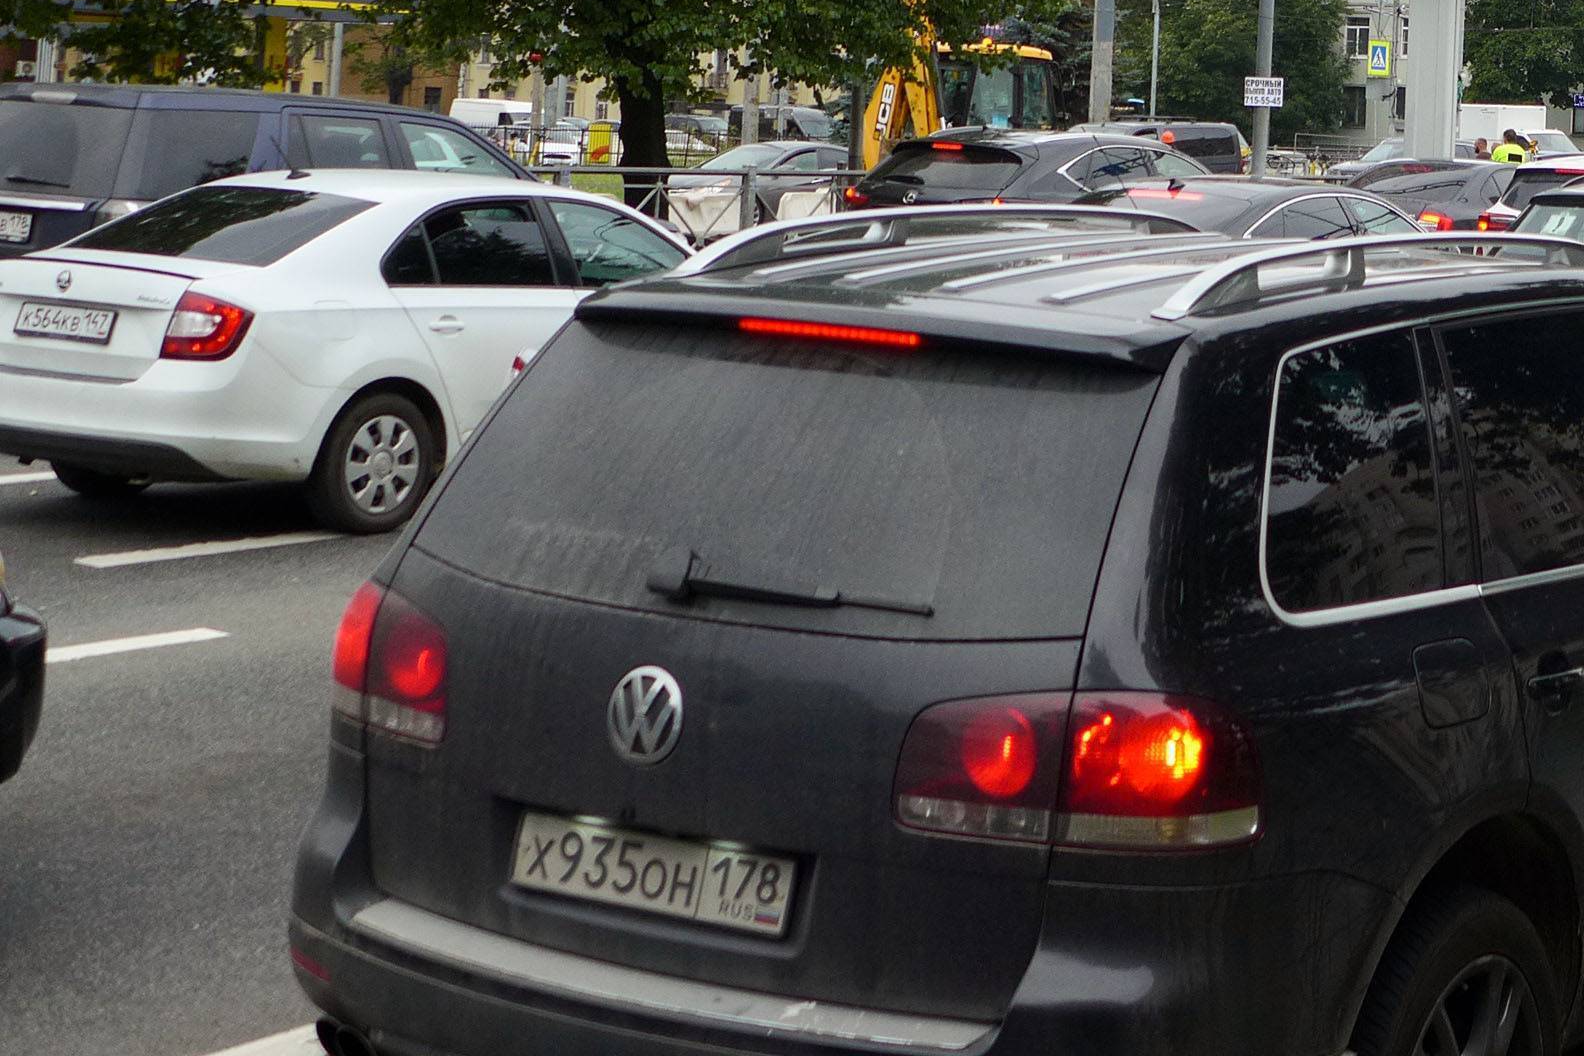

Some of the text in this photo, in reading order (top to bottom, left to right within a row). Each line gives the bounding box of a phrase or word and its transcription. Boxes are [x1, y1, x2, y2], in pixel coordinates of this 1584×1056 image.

[22, 308, 109, 332] К564КВ 147
[526, 831, 782, 907] Х935ОН 178
[718, 898, 755, 920] RUS
